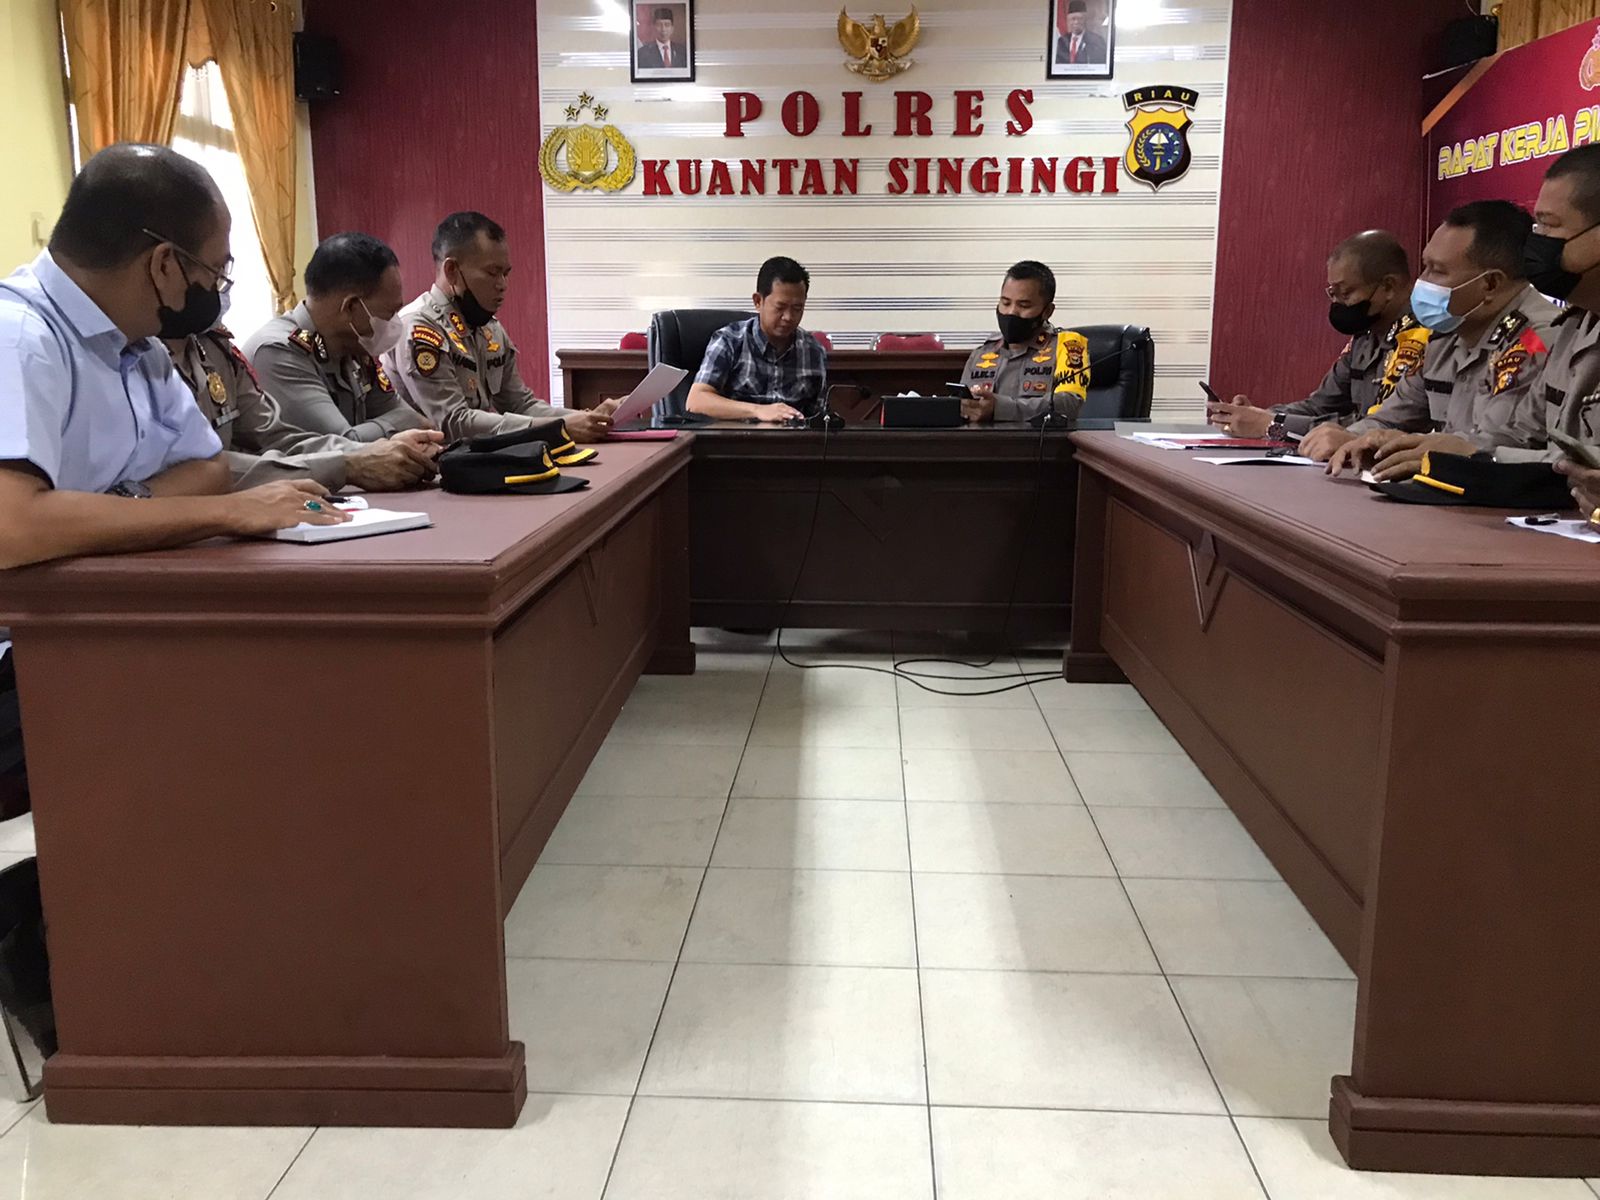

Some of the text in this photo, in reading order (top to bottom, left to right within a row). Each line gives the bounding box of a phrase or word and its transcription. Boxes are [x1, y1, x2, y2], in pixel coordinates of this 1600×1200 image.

[722, 90, 1034, 137] POLRES
[1133, 89, 1191, 102] RIAU
[1438, 105, 1600, 180] RAPAT KERJA PI
[641, 156, 1120, 195] KUANTAN SINGINGI
